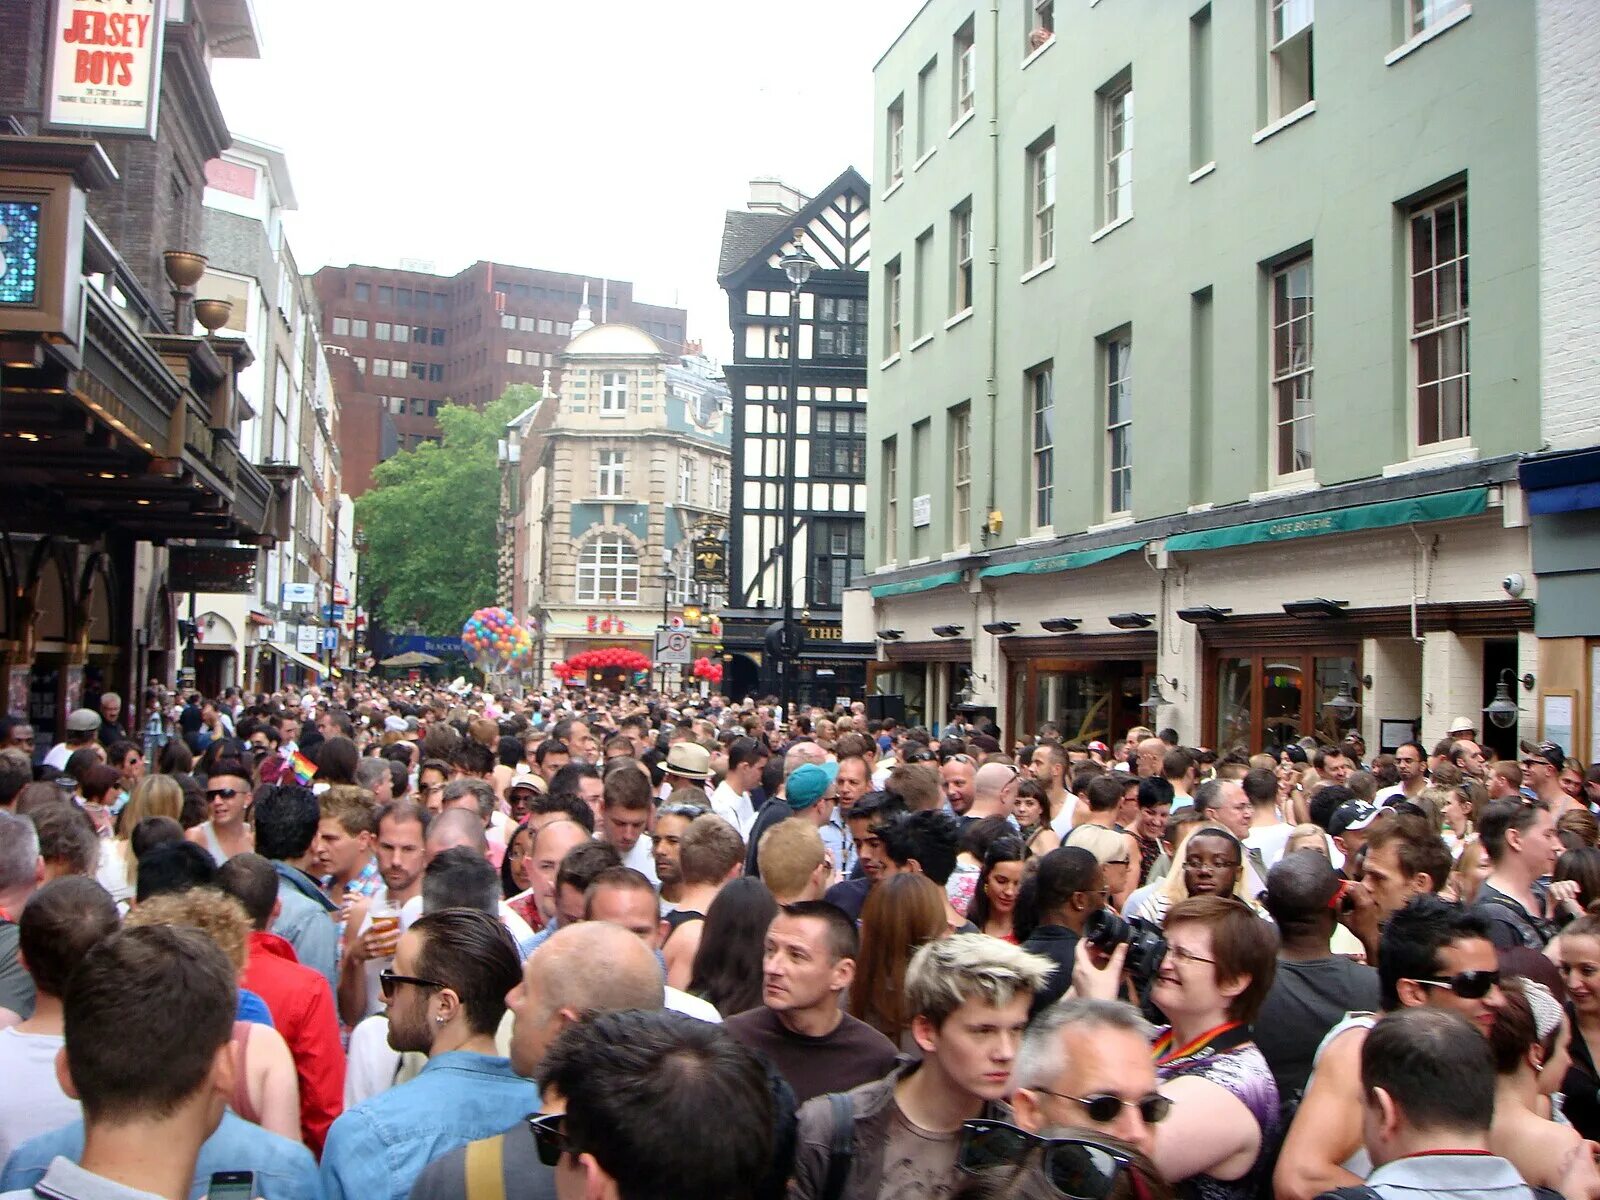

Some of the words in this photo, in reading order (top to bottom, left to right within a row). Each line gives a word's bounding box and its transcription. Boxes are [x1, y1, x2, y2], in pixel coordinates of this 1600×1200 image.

[64, 9, 150, 48] JERSEY
[75, 49, 133, 86] BOYS
[808, 627, 842, 639] THE
